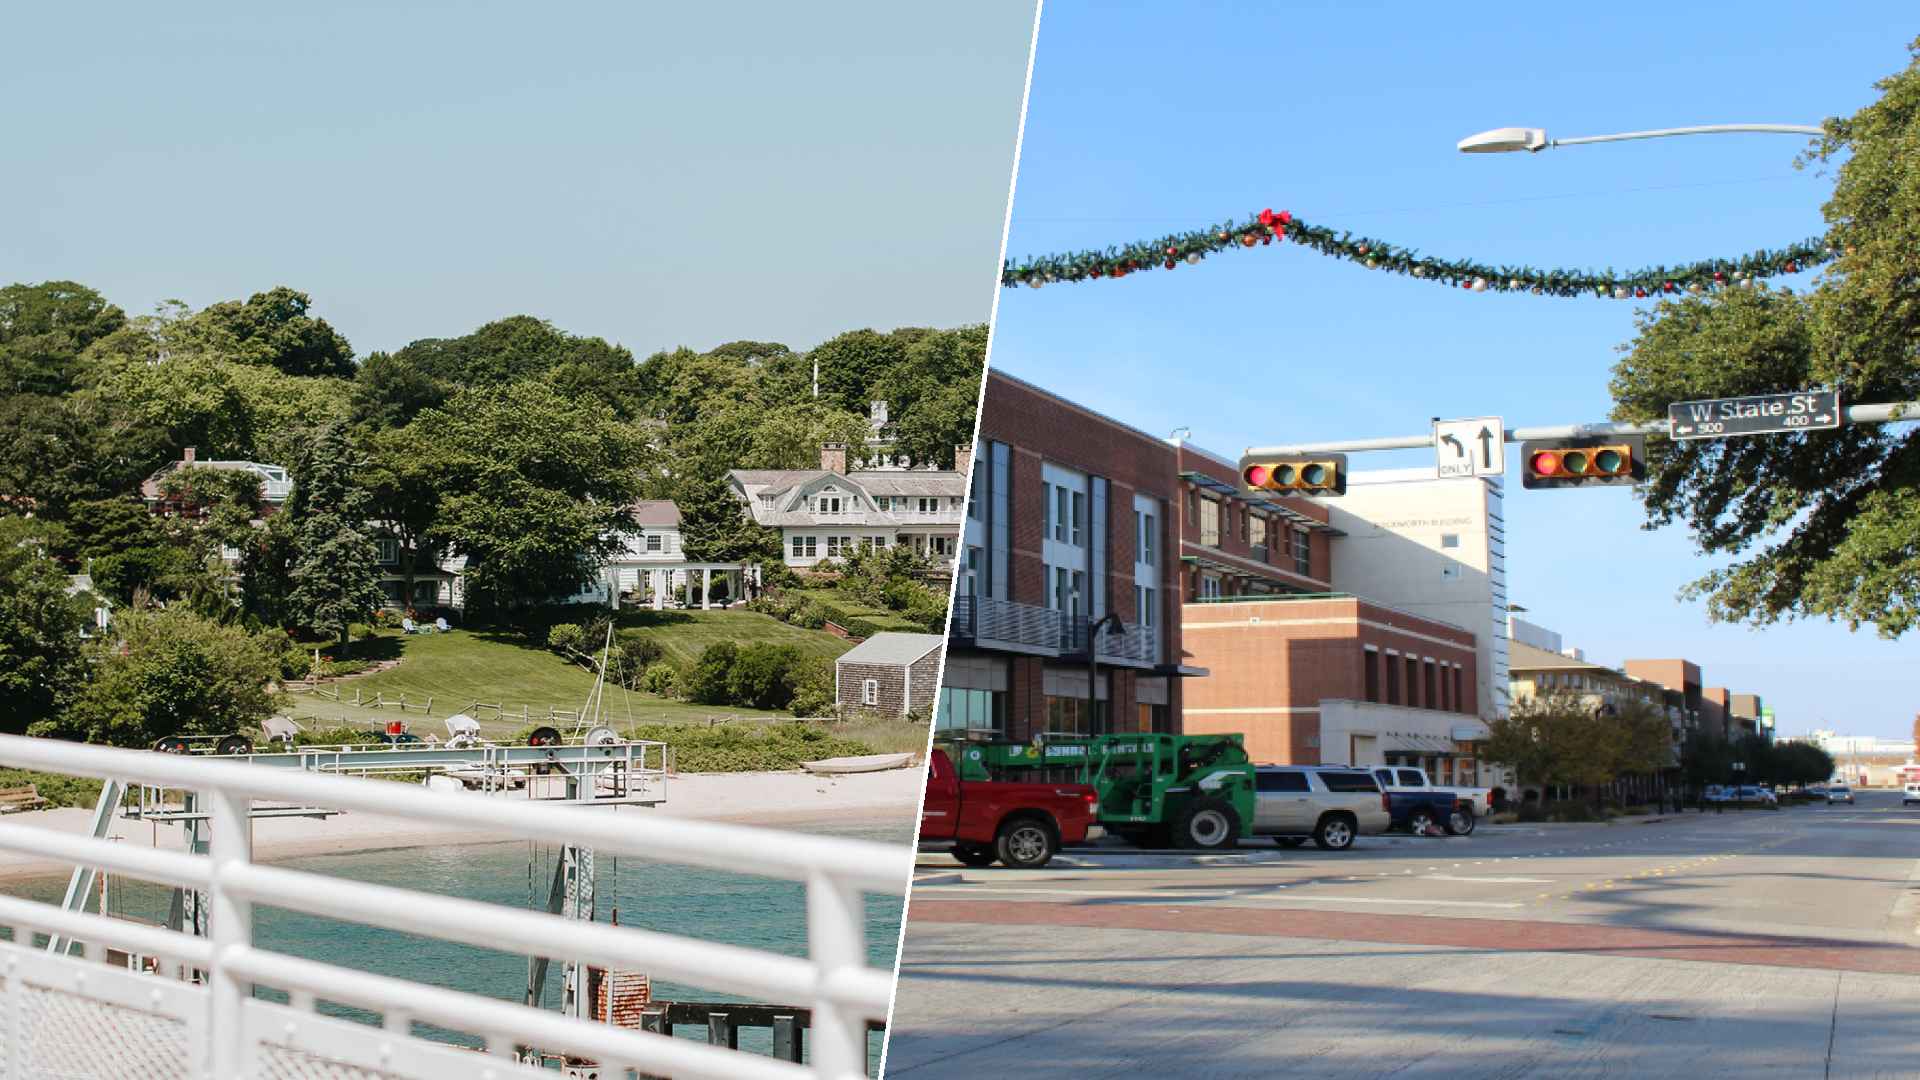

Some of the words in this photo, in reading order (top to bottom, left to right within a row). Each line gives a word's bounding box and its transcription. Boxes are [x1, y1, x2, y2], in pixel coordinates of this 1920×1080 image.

[1690, 405, 1712, 422] W
[1720, 401, 1784, 420] State
[1791, 395, 1817, 414] St
[1783, 415, 1809, 426] 400
[1440, 464, 1471, 474] ONLY
